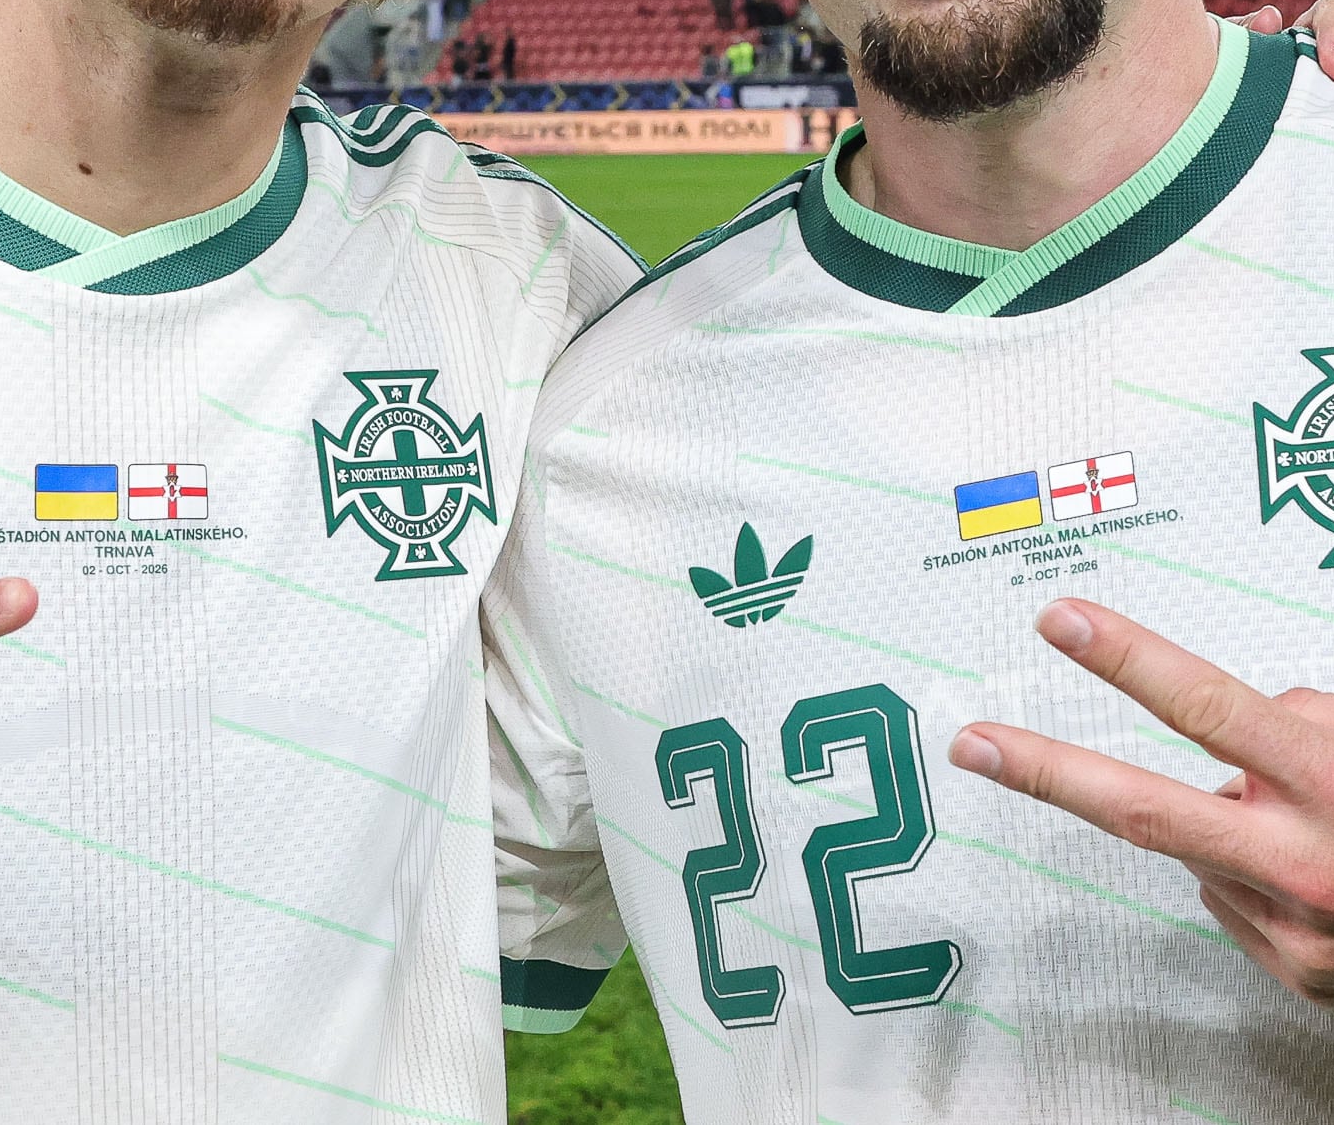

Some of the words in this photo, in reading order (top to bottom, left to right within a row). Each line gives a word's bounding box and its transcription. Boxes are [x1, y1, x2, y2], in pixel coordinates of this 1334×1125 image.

[652, 120, 689, 137] НА
[700, 119, 771, 140] ПОЛІ
[358, 416, 387, 455] IRISH
[385, 410, 449, 451] FOOTBALL
[350, 466, 415, 483] NORTHERN
[415, 463, 466, 479] IRELAND
[371, 497, 458, 537] ASSOCIATION
[65, 530, 127, 543] ANTONA
[94, 545, 154, 558] TRNAVA
[923, 546, 987, 572] ŠTADIÓN
[992, 533, 1055, 557] ANTONA
[1022, 543, 1083, 566] TRNAVA
[82, 565, 96, 575] 02
[106, 565, 131, 575] OCT
[141, 563, 168, 575] 2026
[1011, 574, 1024, 586] 02
[1035, 567, 1060, 581] OCT
[1071, 559, 1098, 574] 2026
[655, 683, 963, 1031] 22
